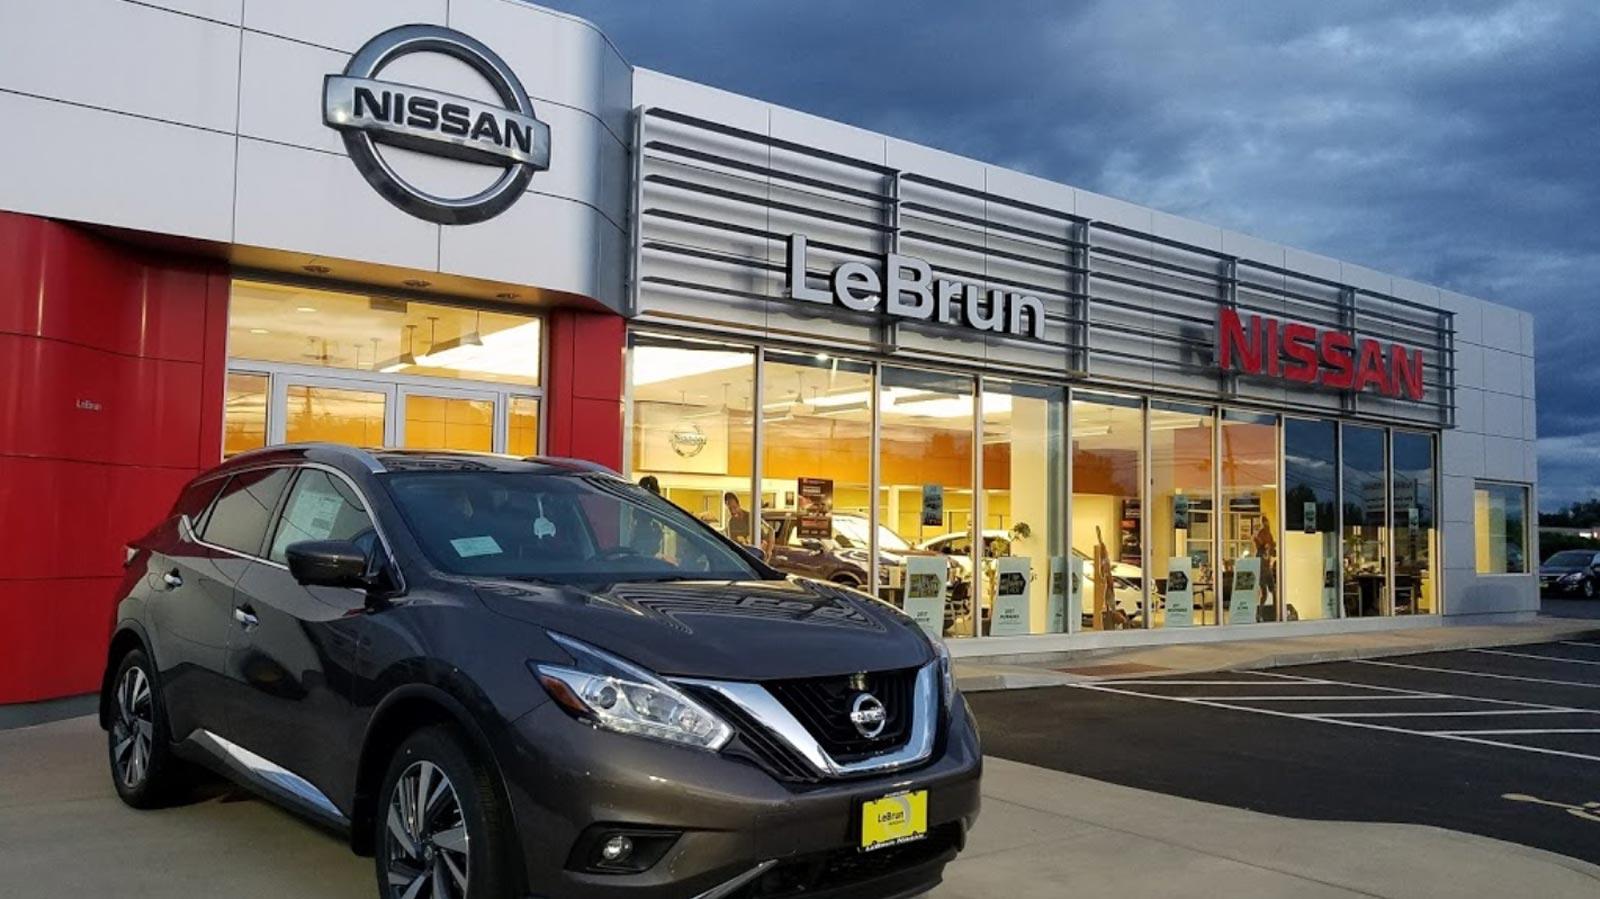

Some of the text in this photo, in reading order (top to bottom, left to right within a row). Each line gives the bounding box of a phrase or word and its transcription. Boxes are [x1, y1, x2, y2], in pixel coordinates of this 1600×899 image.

[353, 86, 533, 154] NISSAN
[787, 233, 1045, 340] LeBrun
[1219, 306, 1425, 400] NISSAN
